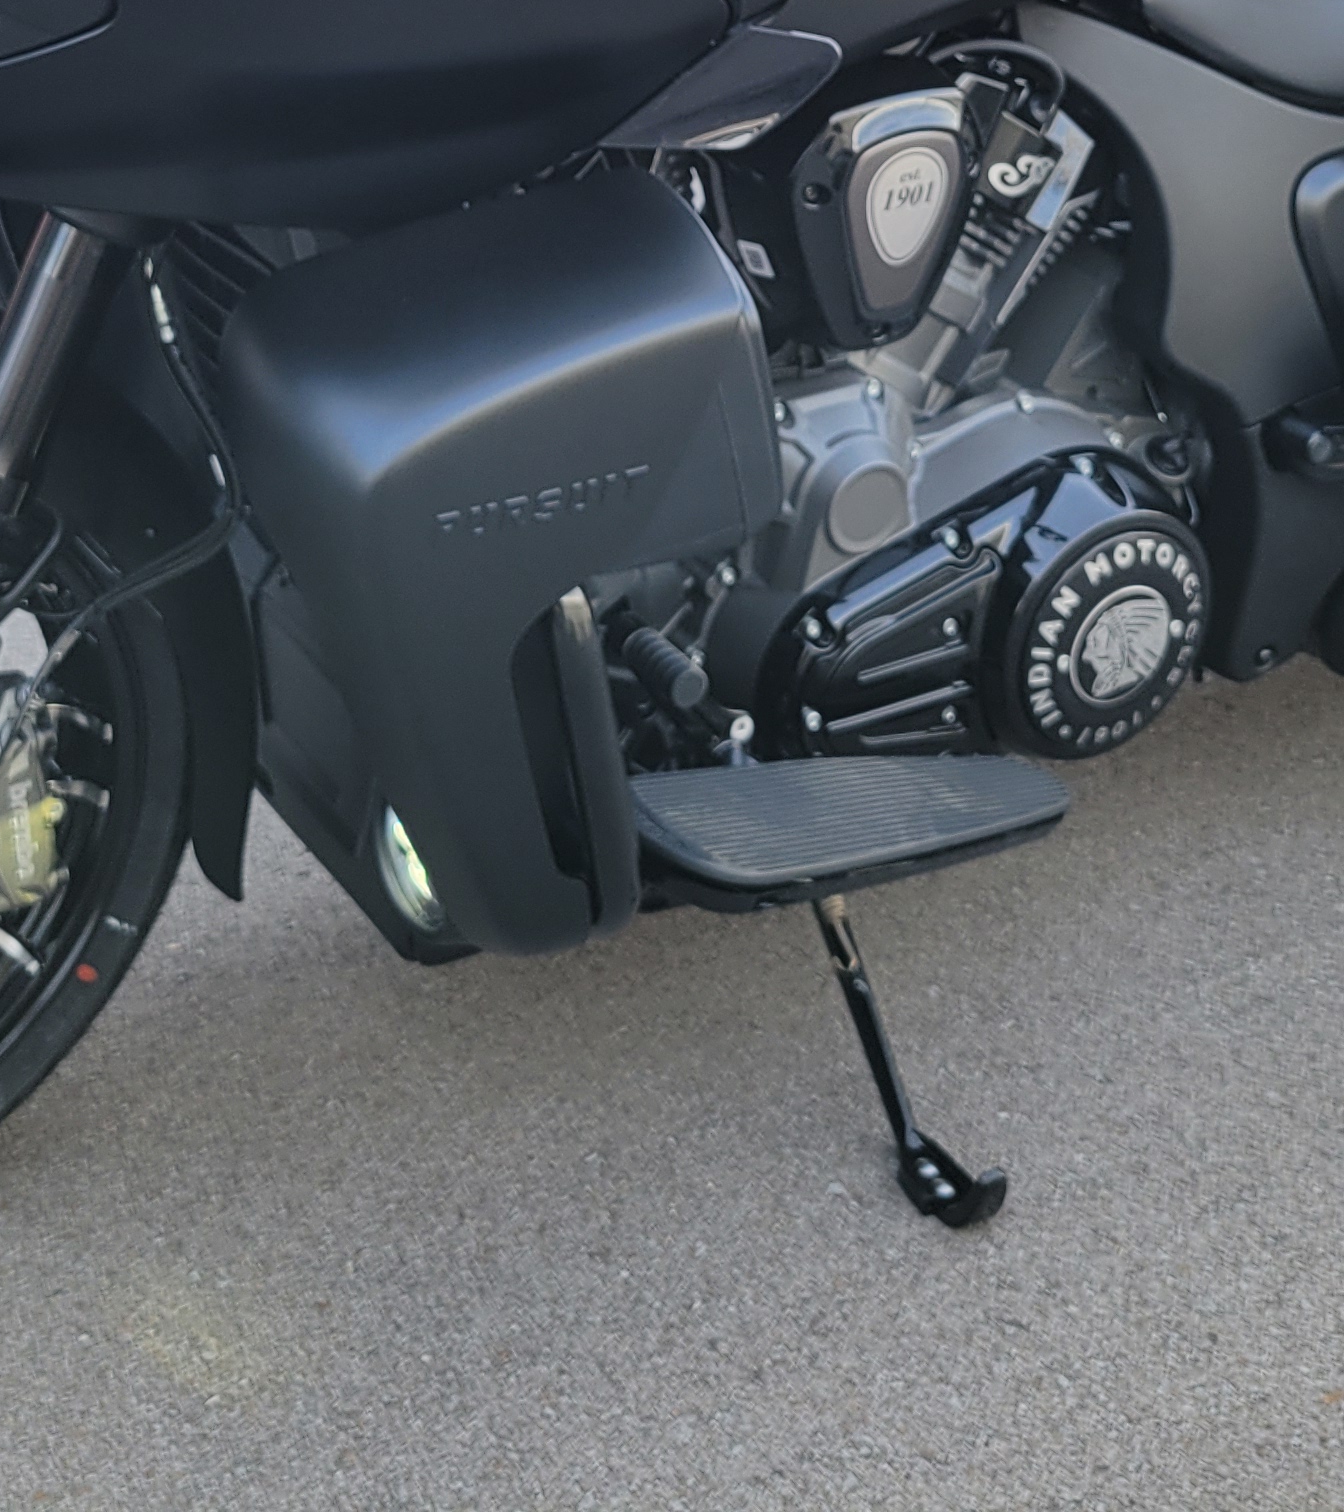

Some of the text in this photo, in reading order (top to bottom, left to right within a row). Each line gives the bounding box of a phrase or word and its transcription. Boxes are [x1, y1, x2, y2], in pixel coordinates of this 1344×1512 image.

[884, 181, 934, 210] 1901
[433, 464, 650, 538] PURSUIT
[1027, 538, 1203, 729] INDIAN MOTORCYCLE
